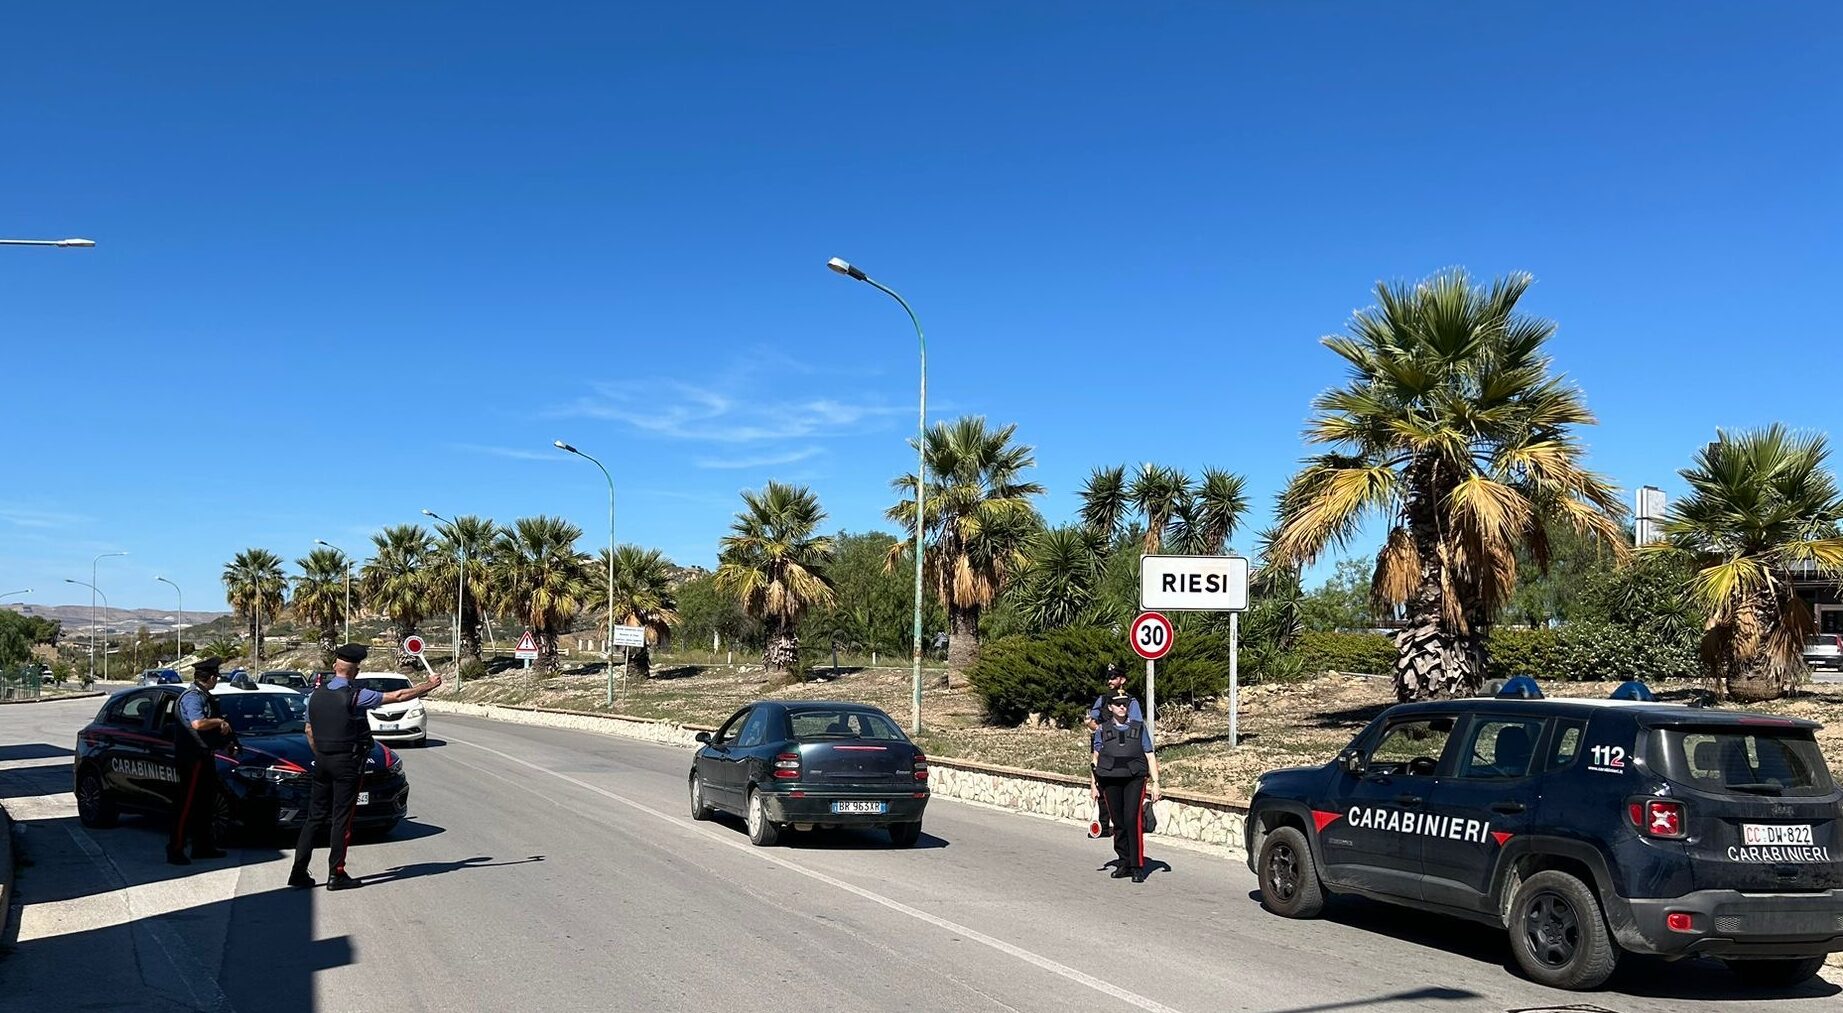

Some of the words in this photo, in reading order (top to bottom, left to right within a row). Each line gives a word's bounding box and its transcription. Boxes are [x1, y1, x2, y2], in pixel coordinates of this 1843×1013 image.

[1162, 573, 1228, 593] RIESI
[1140, 625, 1164, 646] 30
[1591, 745, 1625, 767] 112
[111, 757, 177, 783] CARABINIERI
[839, 802, 850, 812] BR
[853, 802, 880, 813] 963XR
[1348, 806, 1490, 844] CARABINIERI
[1746, 826, 1761, 842] CC
[1787, 827, 1810, 843] 822
[1727, 846, 1831, 862] CARABINIERI
